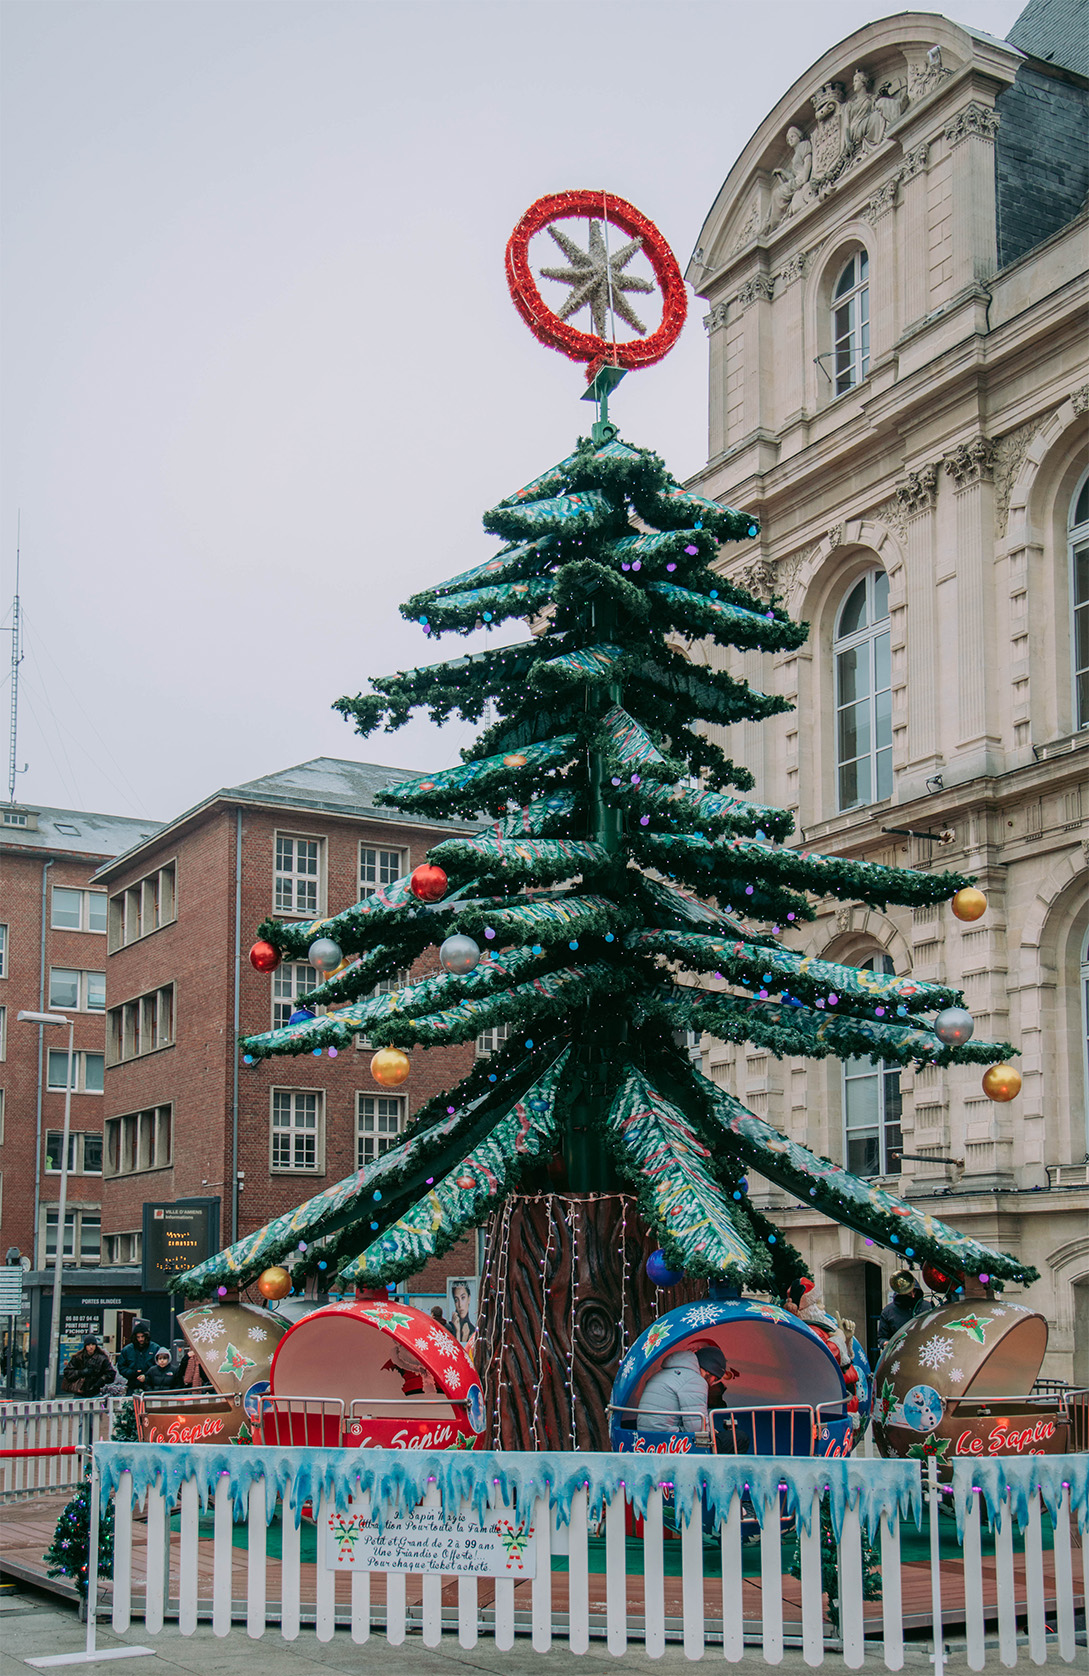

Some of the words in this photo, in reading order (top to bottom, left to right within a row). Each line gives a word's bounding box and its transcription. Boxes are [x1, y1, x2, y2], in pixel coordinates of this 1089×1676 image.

[167, 1418, 224, 1444] Sapin
[391, 1424, 452, 1450] Sapin
[956, 1430, 984, 1454] Le
[988, 1421, 1056, 1452] Sapin
[409, 1510, 434, 1523] Sapin
[359, 1518, 402, 1530] Attration
[456, 1523, 464, 1532] la
[364, 1535, 386, 1546] Petit
[388, 1536, 398, 1546] et
[398, 1536, 428, 1548] Grand
[432, 1538, 442, 1548] de
[447, 1538, 454, 1548] 2
[464, 1539, 477, 1549] 99
[373, 1546, 392, 1556] Une
[396, 1547, 438, 1558] Friandise
[367, 1556, 390, 1567] Pour
[392, 1558, 426, 1572] chaque
[427, 1559, 456, 1570] ticket
